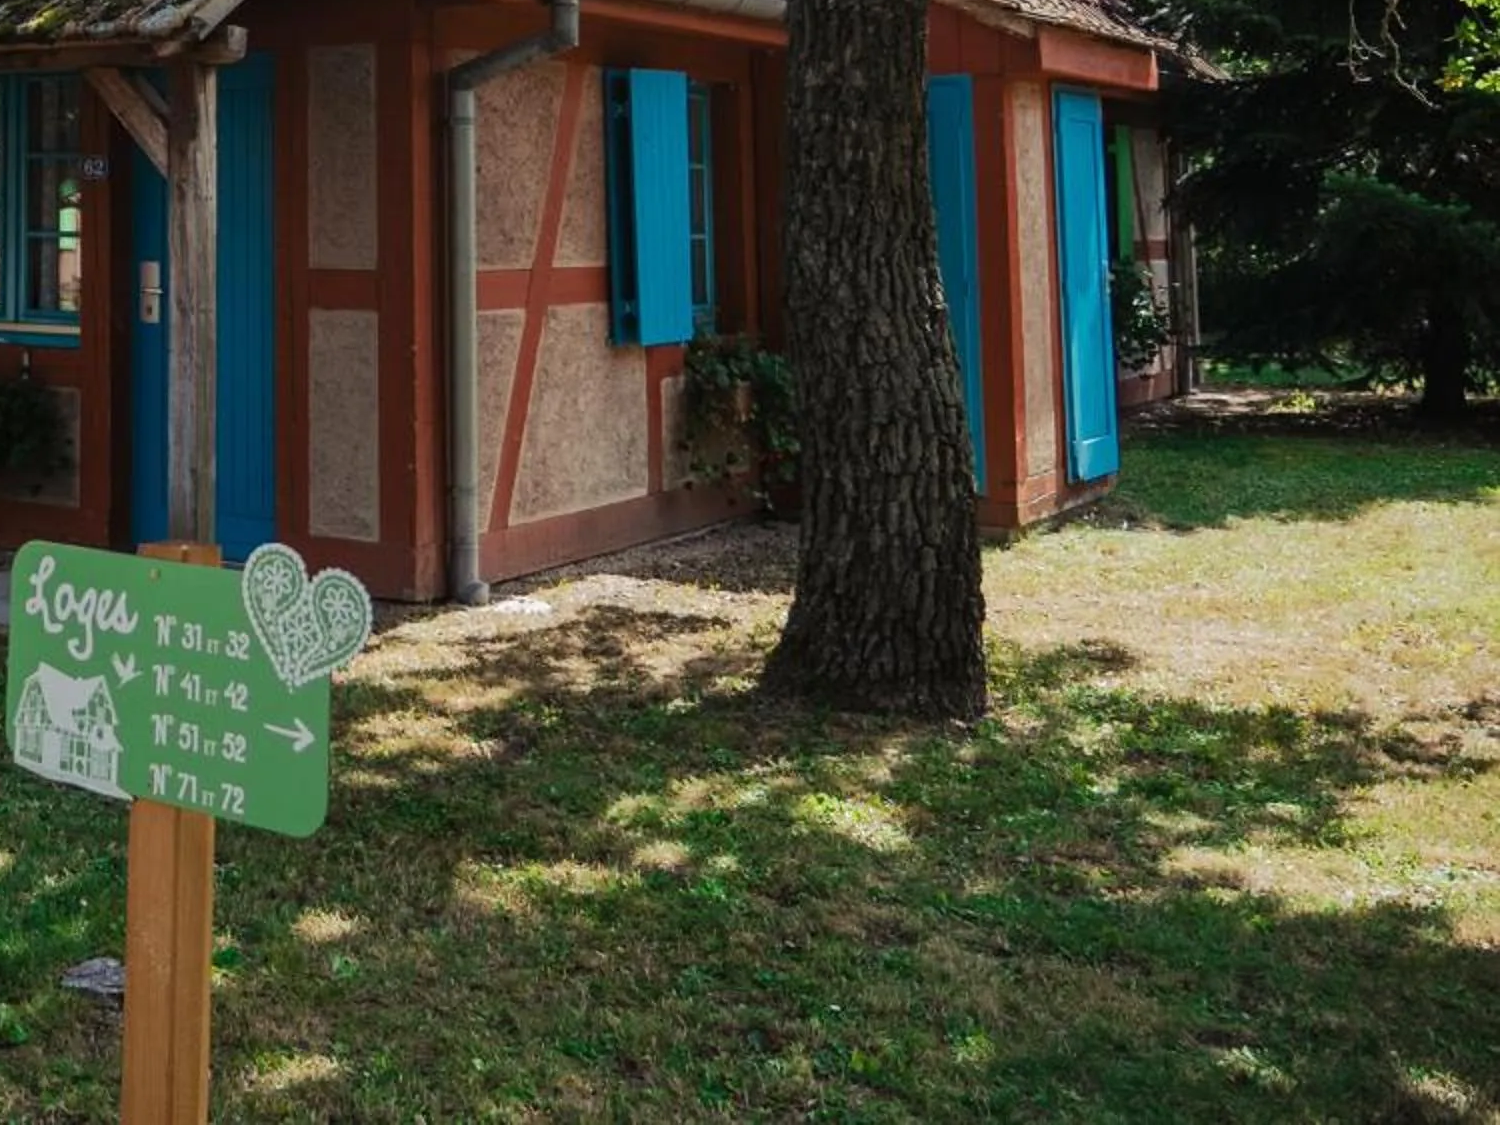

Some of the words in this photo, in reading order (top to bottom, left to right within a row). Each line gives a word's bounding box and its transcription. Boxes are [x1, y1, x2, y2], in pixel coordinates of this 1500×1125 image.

[83, 159, 104, 176] 62
[25, 555, 139, 661] Loges
[181, 622, 202, 651] 31
[225, 630, 250, 660] 32
[180, 671, 201, 702] 41
[223, 680, 248, 712] 42
[179, 722, 199, 753] 51
[221, 731, 247, 764] 52
[177, 772, 197, 803] 71
[221, 782, 245, 814] 72
